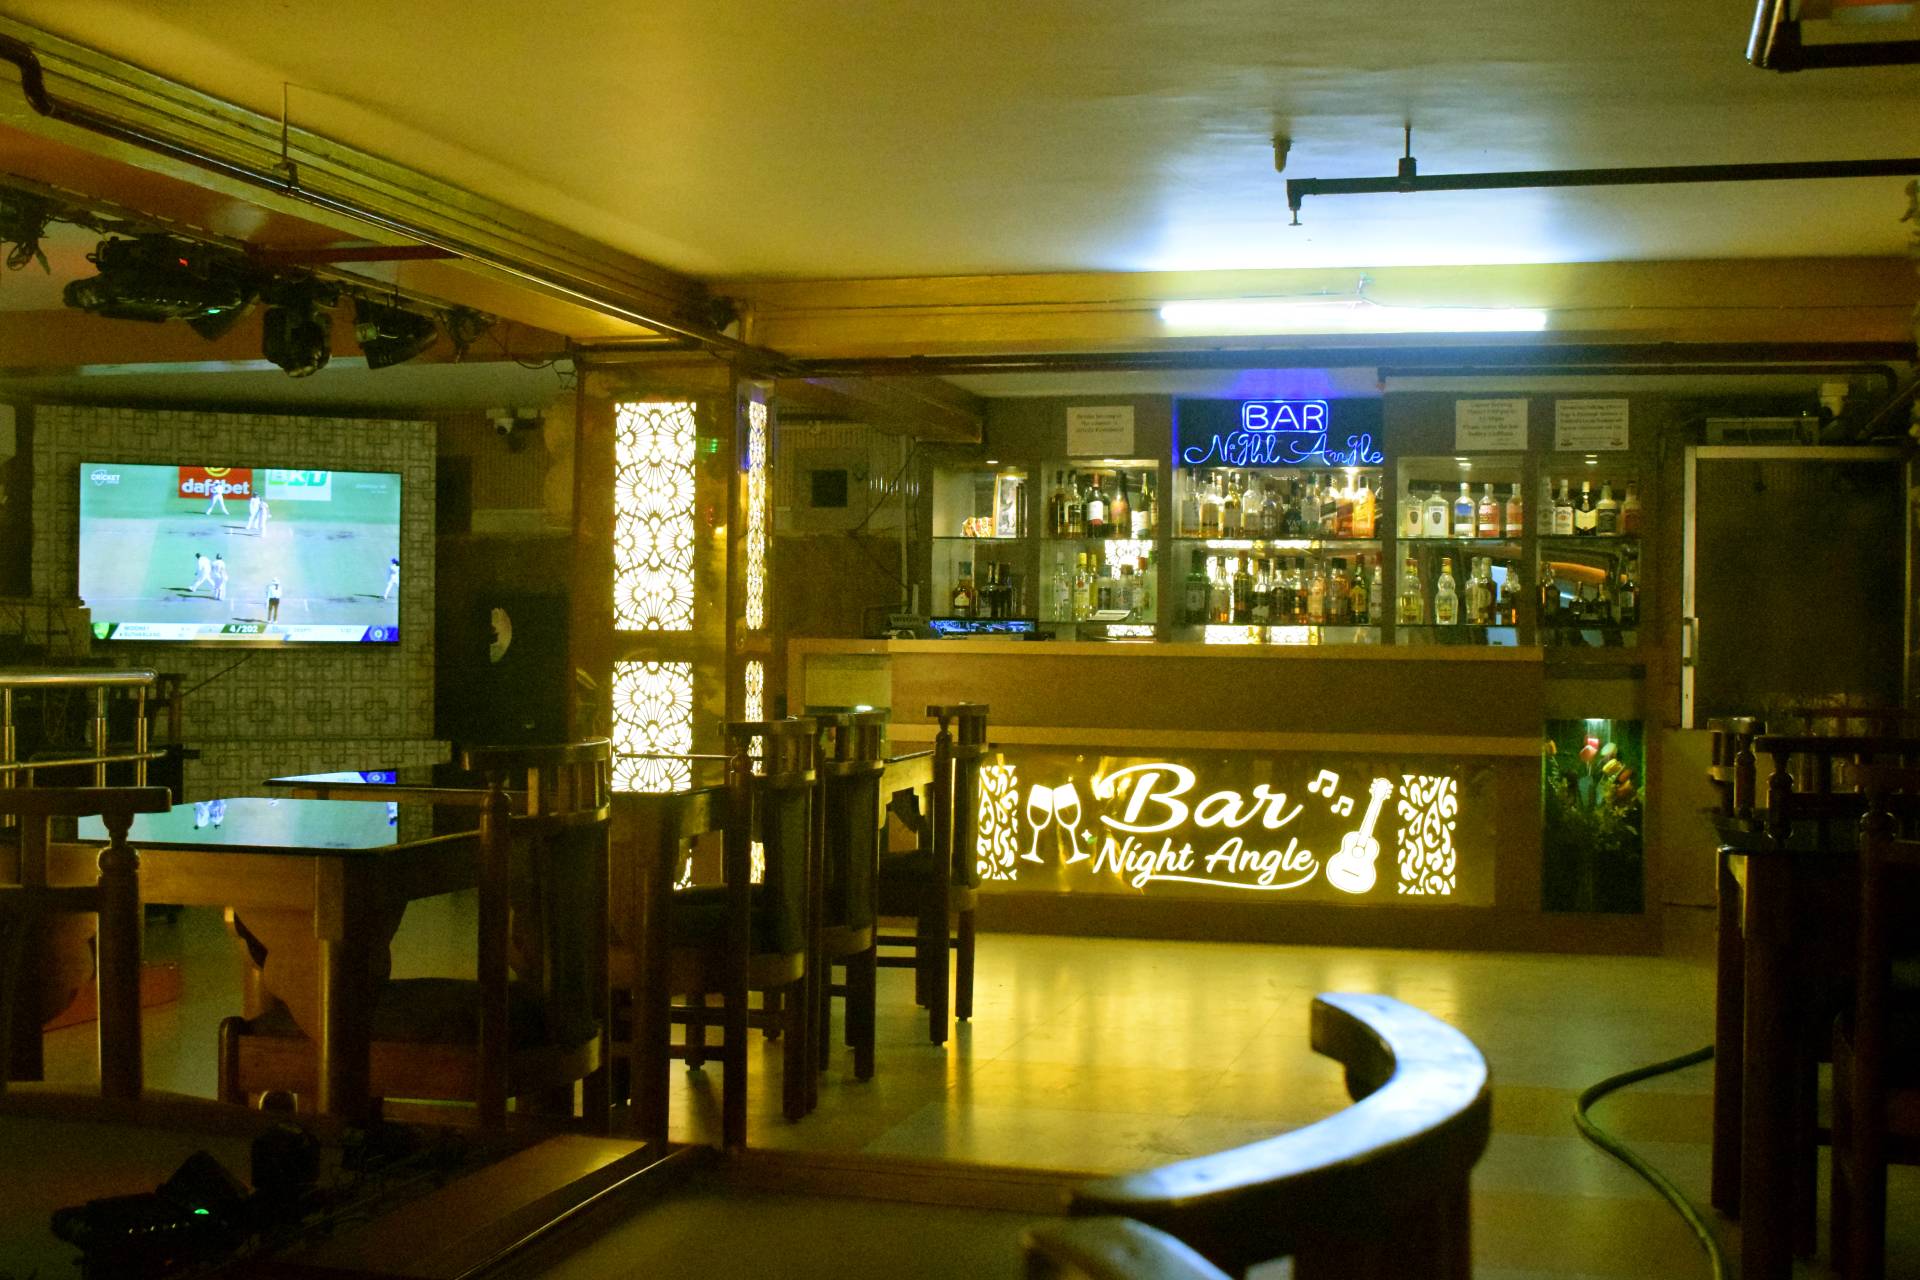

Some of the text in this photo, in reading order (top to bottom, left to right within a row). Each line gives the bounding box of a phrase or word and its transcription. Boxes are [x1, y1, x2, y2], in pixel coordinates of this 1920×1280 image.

[1245, 405, 1324, 430] BAR
[1282, 433, 1384, 466] Angle
[229, 624, 258, 633] 4/202
[1100, 763, 1303, 833] Bar
[1093, 836, 1319, 889] Night Angle
